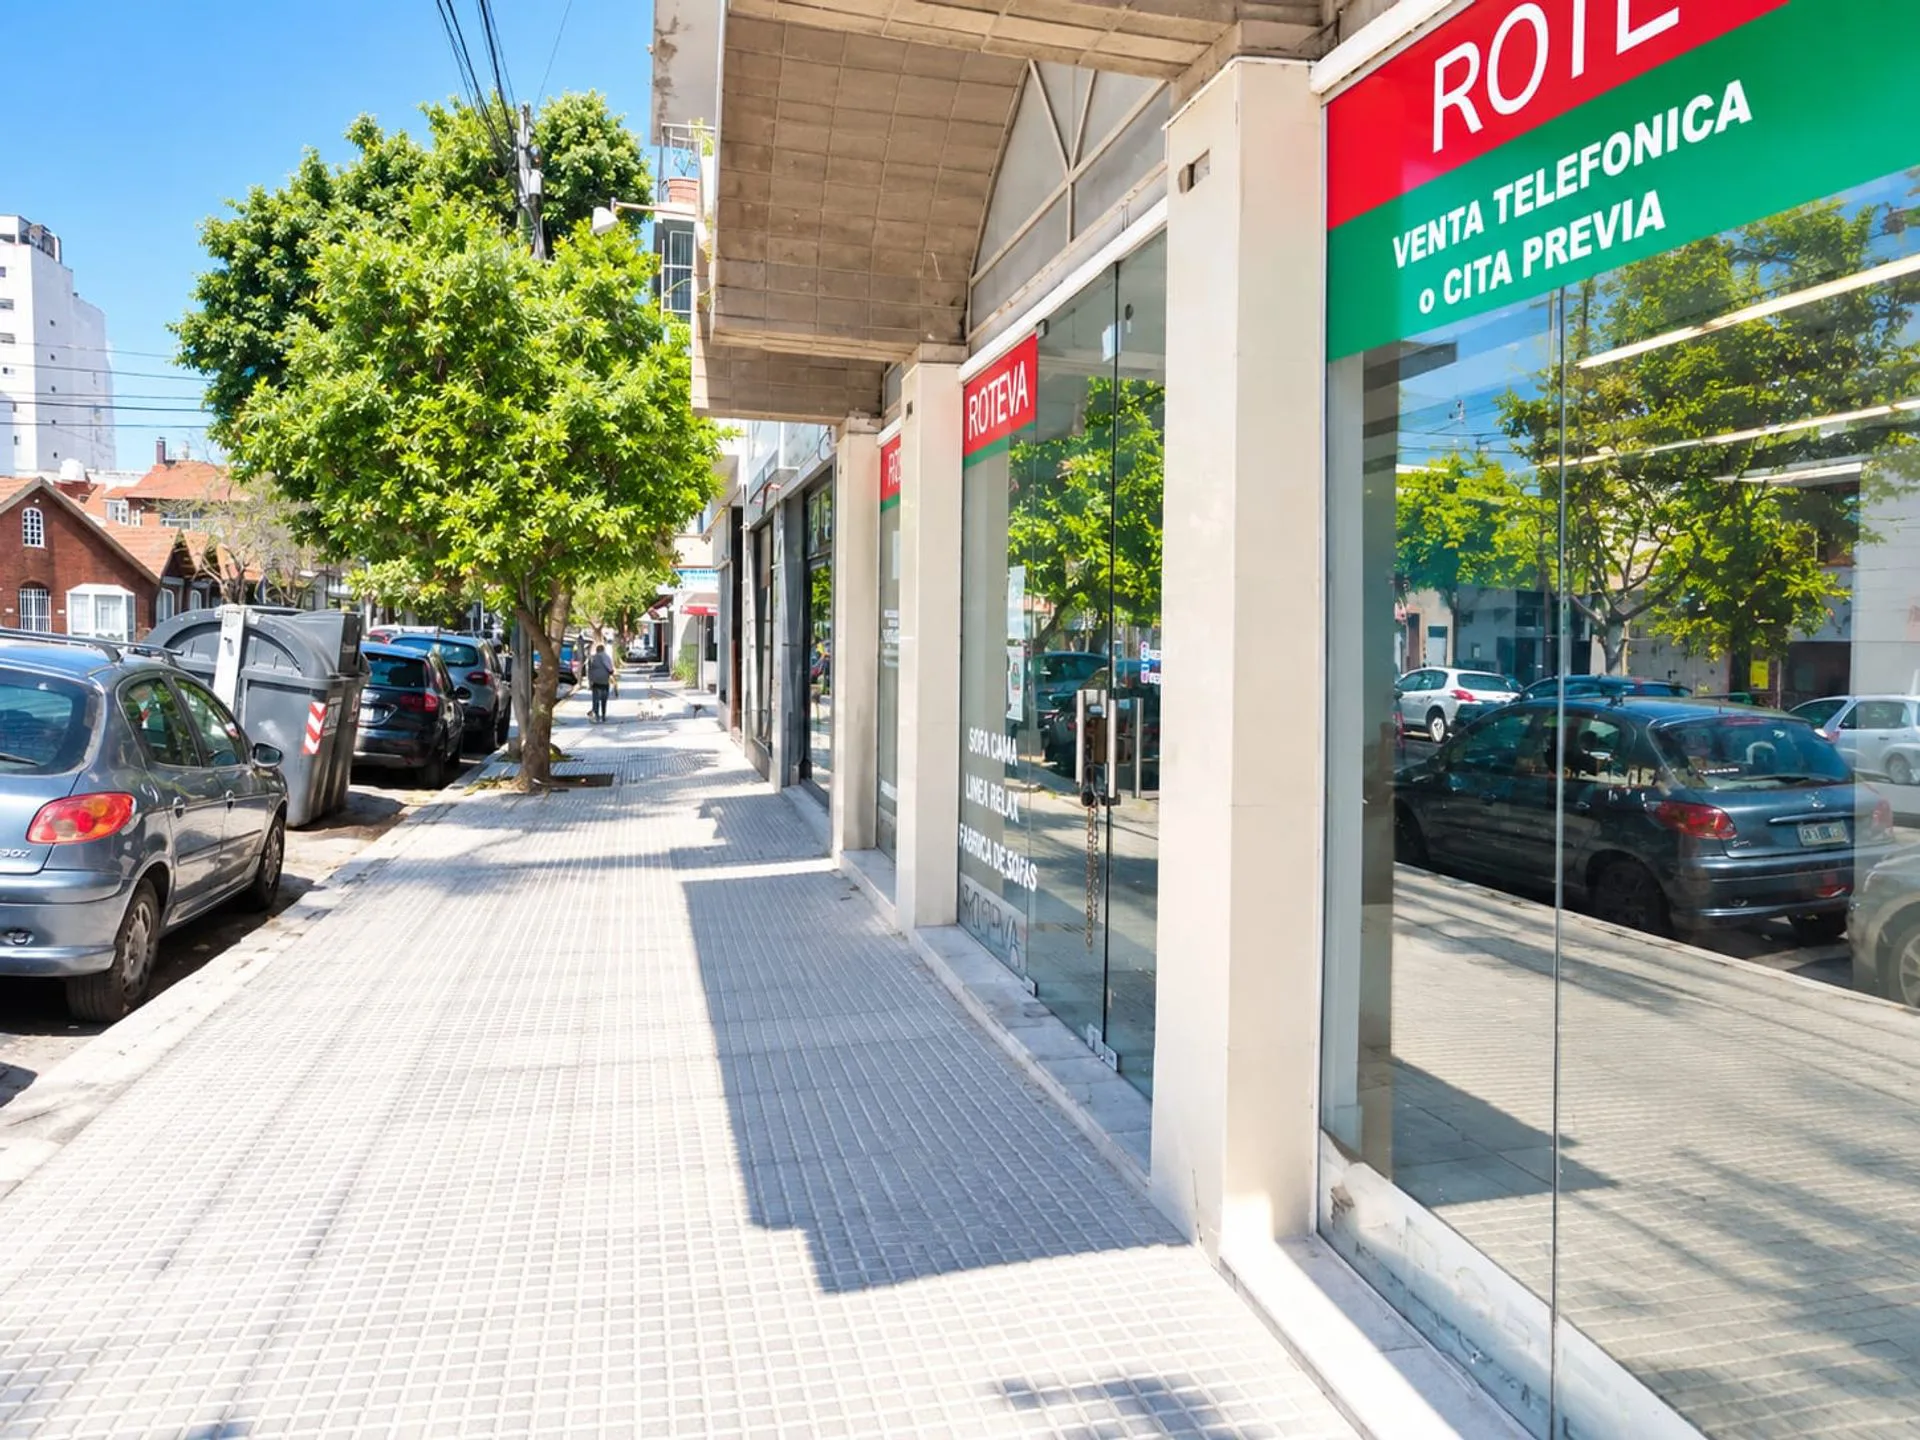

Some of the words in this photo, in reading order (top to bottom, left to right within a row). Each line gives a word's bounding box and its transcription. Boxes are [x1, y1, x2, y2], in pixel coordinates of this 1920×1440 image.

[1393, 200, 1484, 268] VENTA
[1493, 80, 1753, 225] TELEFONICA
[1443, 256, 1513, 305] CITA
[1522, 190, 1666, 279] PREVIA
[968, 360, 1029, 441] ROTEVA
[968, 727, 990, 758] SOFA
[991, 732, 1018, 766] CAMA
[959, 823, 992, 866] FABRICA
[993, 841, 1006, 875] DE
[1006, 850, 1037, 892] SOFAS
